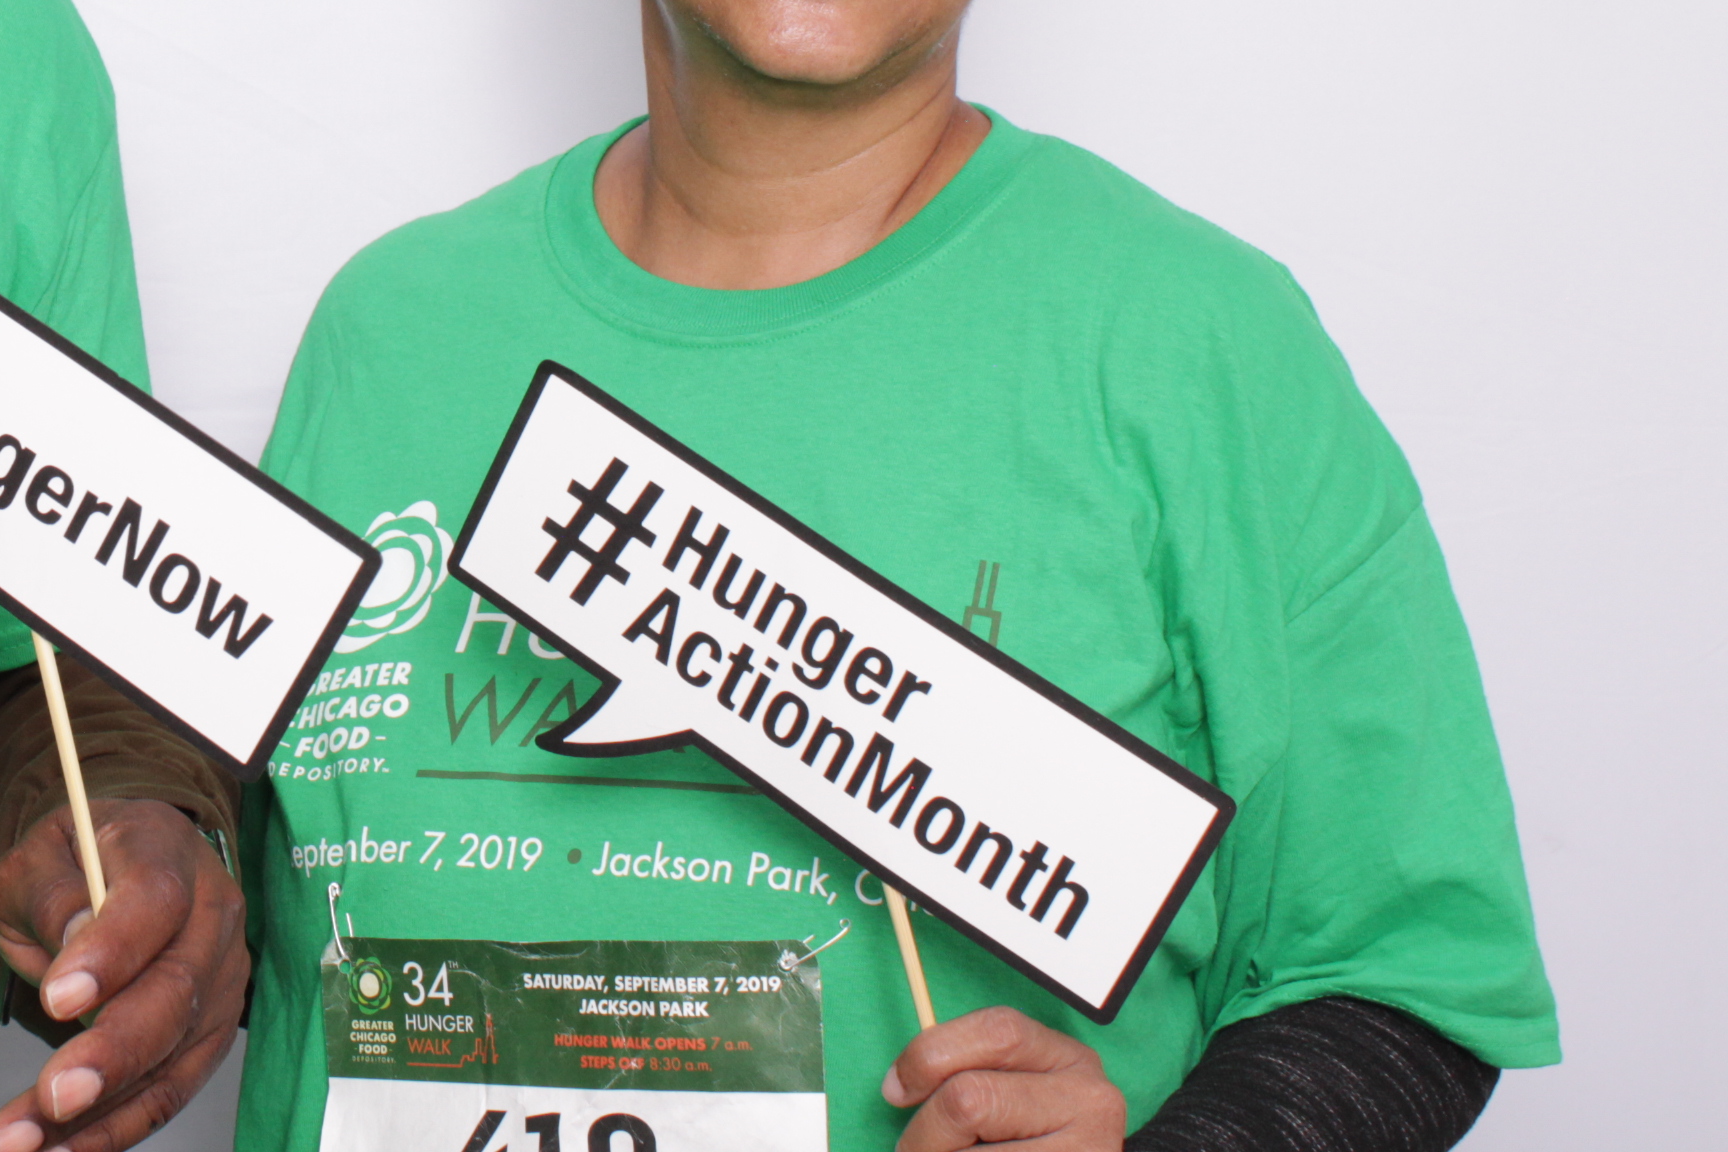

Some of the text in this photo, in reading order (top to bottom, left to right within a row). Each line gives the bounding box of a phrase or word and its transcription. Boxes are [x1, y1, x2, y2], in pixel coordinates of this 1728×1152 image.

[445, 673, 578, 747] WA
[622, 587, 1090, 941] ActionMonth
[290, 826, 412, 879] epteber
[419, 831, 447, 872] 7,
[456, 832, 543, 872] 2019
[592, 841, 733, 884] Jackson
[747, 851, 838, 906] Park,
[523, 973, 782, 995] SATURDAY, SEPTEMBER 7, 2019
[579, 999, 710, 1018] JACKSON PARK
[351, 1020, 395, 1031] GREATER
[405, 1014, 474, 1033] HUNGER
[350, 1032, 397, 1044] CHICAGO
[407, 1037, 452, 1055] WALK
[554, 1034, 754, 1051] HUNGER WALK OPENS 7 a.m.
[580, 1056, 713, 1071] STEPS OFF 8:30 a.m.
